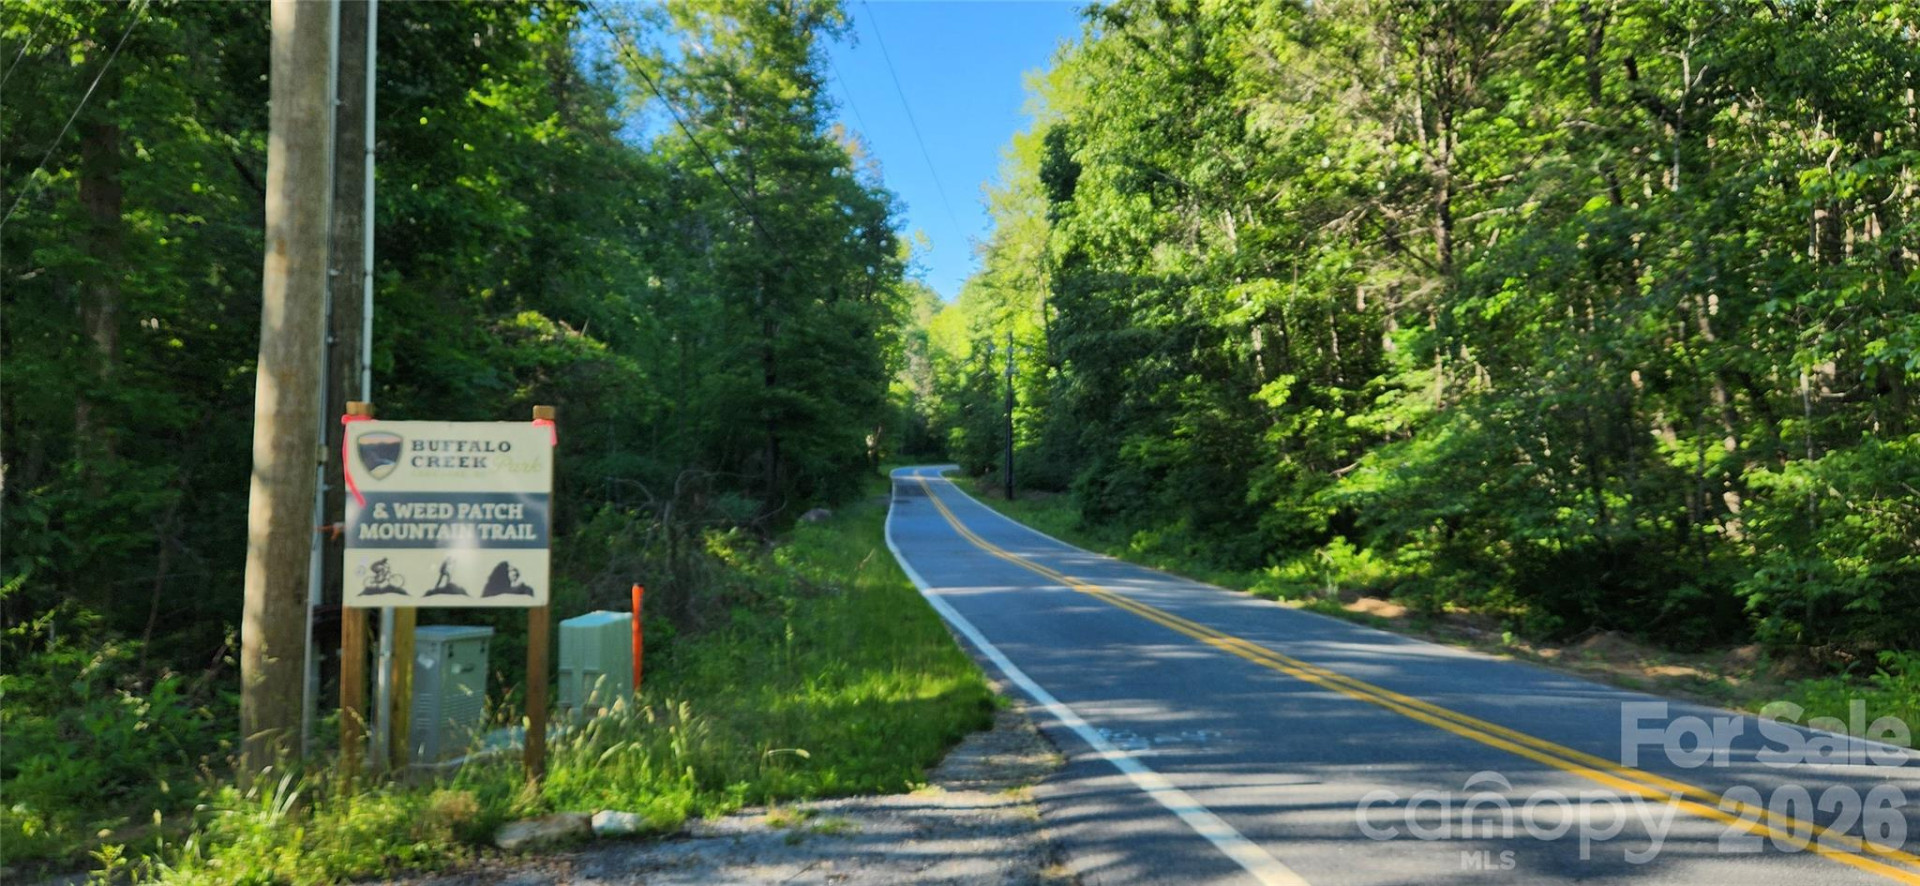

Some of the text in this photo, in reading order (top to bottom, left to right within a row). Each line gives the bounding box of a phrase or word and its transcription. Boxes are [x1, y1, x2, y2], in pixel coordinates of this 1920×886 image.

[411, 440, 511, 453] BUFFALO
[411, 456, 487, 468] CREEK
[373, 503, 523, 520] & WEED PATCH
[359, 523, 536, 540] MOUNTAIN TRAIL
